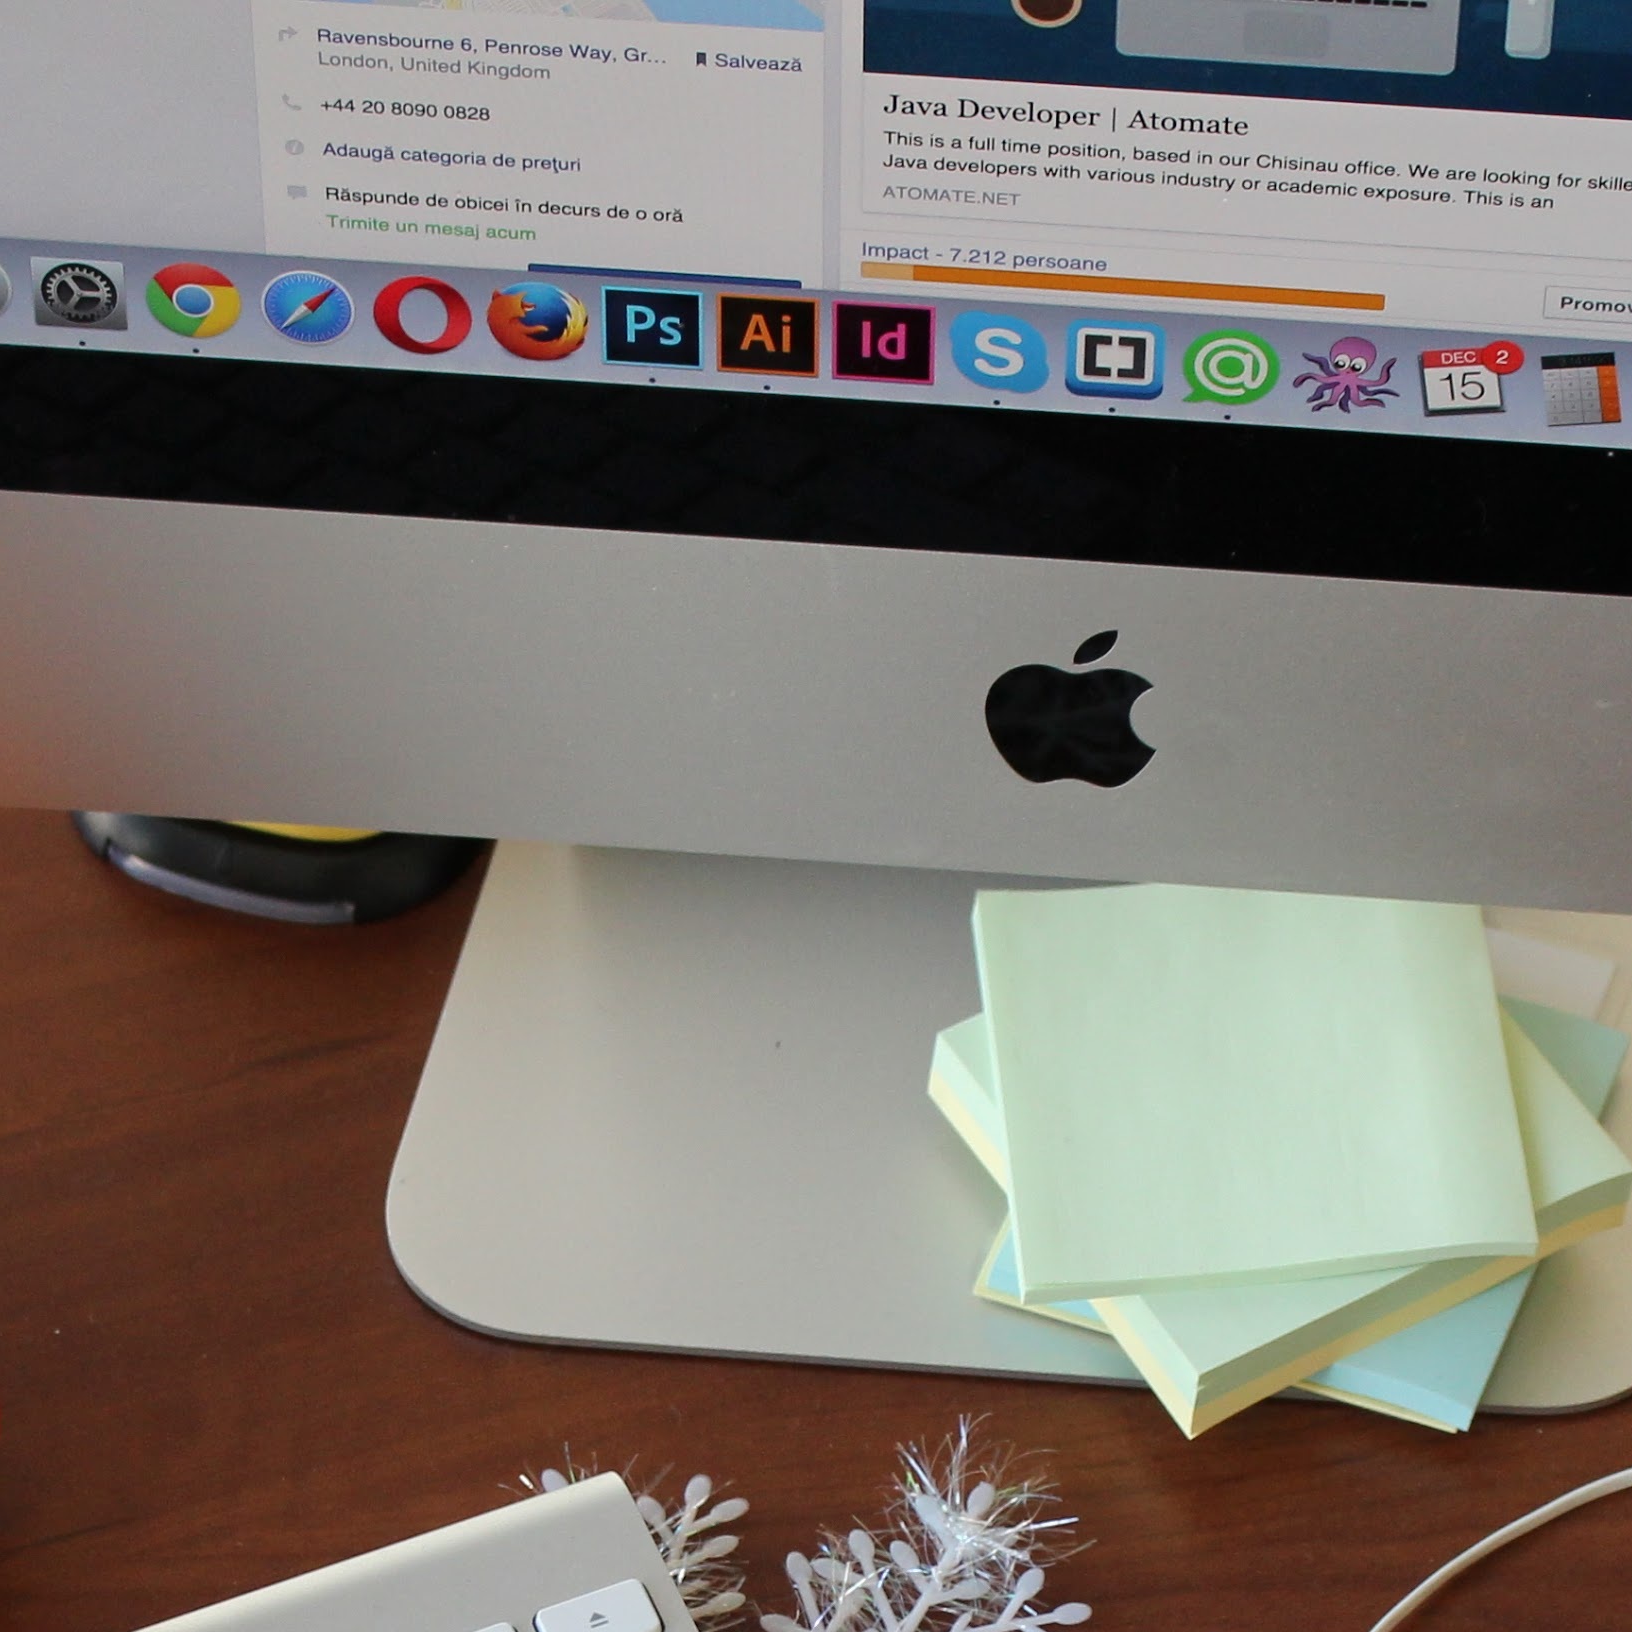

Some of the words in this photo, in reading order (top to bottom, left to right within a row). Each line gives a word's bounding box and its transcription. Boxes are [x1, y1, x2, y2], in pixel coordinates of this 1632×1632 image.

[317, 28, 454, 50] Ravensbourne
[460, 37, 477, 53] 6,
[485, 38, 562, 57] Penrose
[568, 44, 616, 63] Way,
[318, 50, 393, 71] London,
[400, 56, 460, 73] United
[467, 60, 550, 80] Kingdom
[714, 52, 802, 71] Salvează
[320, 98, 355, 112] +44
[362, 100, 384, 114] 20
[391, 101, 437, 117] 8090
[443, 105, 490, 121] 0828
[883, 94, 947, 116] Java
[957, 98, 1100, 129] Developer
[1127, 109, 1248, 135] Atomate
[322, 142, 394, 162] Adaugă
[400, 149, 486, 166] categoria
[492, 153, 515, 167] de
[883, 130, 923, 146] This
[930, 133, 944, 148] is
[950, 138, 961, 149] a
[968, 136, 994, 150] full
[1001, 138, 1041, 153] time
[1047, 143, 1125, 161] position,
[1132, 146, 1190, 163] based
[1197, 150, 1212, 164] in
[1218, 155, 1250, 166] our
[1256, 154, 1338, 172] Chisinau
[1344, 160, 1399, 176] office.
[1408, 163, 1439, 179] We
[1445, 169, 1476, 181] are
[1482, 168, 1550, 189] looking
[1557, 172, 1581, 187] for
[882, 153, 927, 169] Java
[933, 156, 1036, 177] developers
[1043, 164, 1080, 178] with
[1086, 168, 1155, 183] various
[1161, 171, 1235, 192] industry
[1241, 178, 1260, 190] or
[1266, 180, 1357, 196] academic
[1363, 186, 1455, 202] exposure.
[1463, 189, 1502, 205] This
[1509, 193, 1524, 207] is
[1530, 197, 1553, 208] an
[882, 185, 1020, 205] ATOMATE.NET
[325, 186, 419, 205] Răspunde
[425, 193, 448, 207] de
[454, 196, 508, 211] obicei
[514, 198, 531, 212] în
[538, 200, 600, 217] decurs
[606, 204, 629, 219] de
[635, 209, 647, 220] o
[653, 208, 683, 222] oră
[325, 214, 389, 231] Trimite
[395, 221, 418, 232] un
[424, 223, 479, 240] mesaj
[485, 227, 536, 240] acum
[862, 241, 928, 261] Impact
[949, 247, 1005, 265] 7.212
[1012, 254, 1107, 271] persoane
[626, 305, 681, 345] Ps
[741, 314, 791, 352] Ai
[862, 321, 905, 360] Id
[975, 328, 1023, 376] S
[1441, 350, 1476, 365] DEC
[1496, 350, 1508, 364] 2
[1441, 372, 1484, 400] 15
